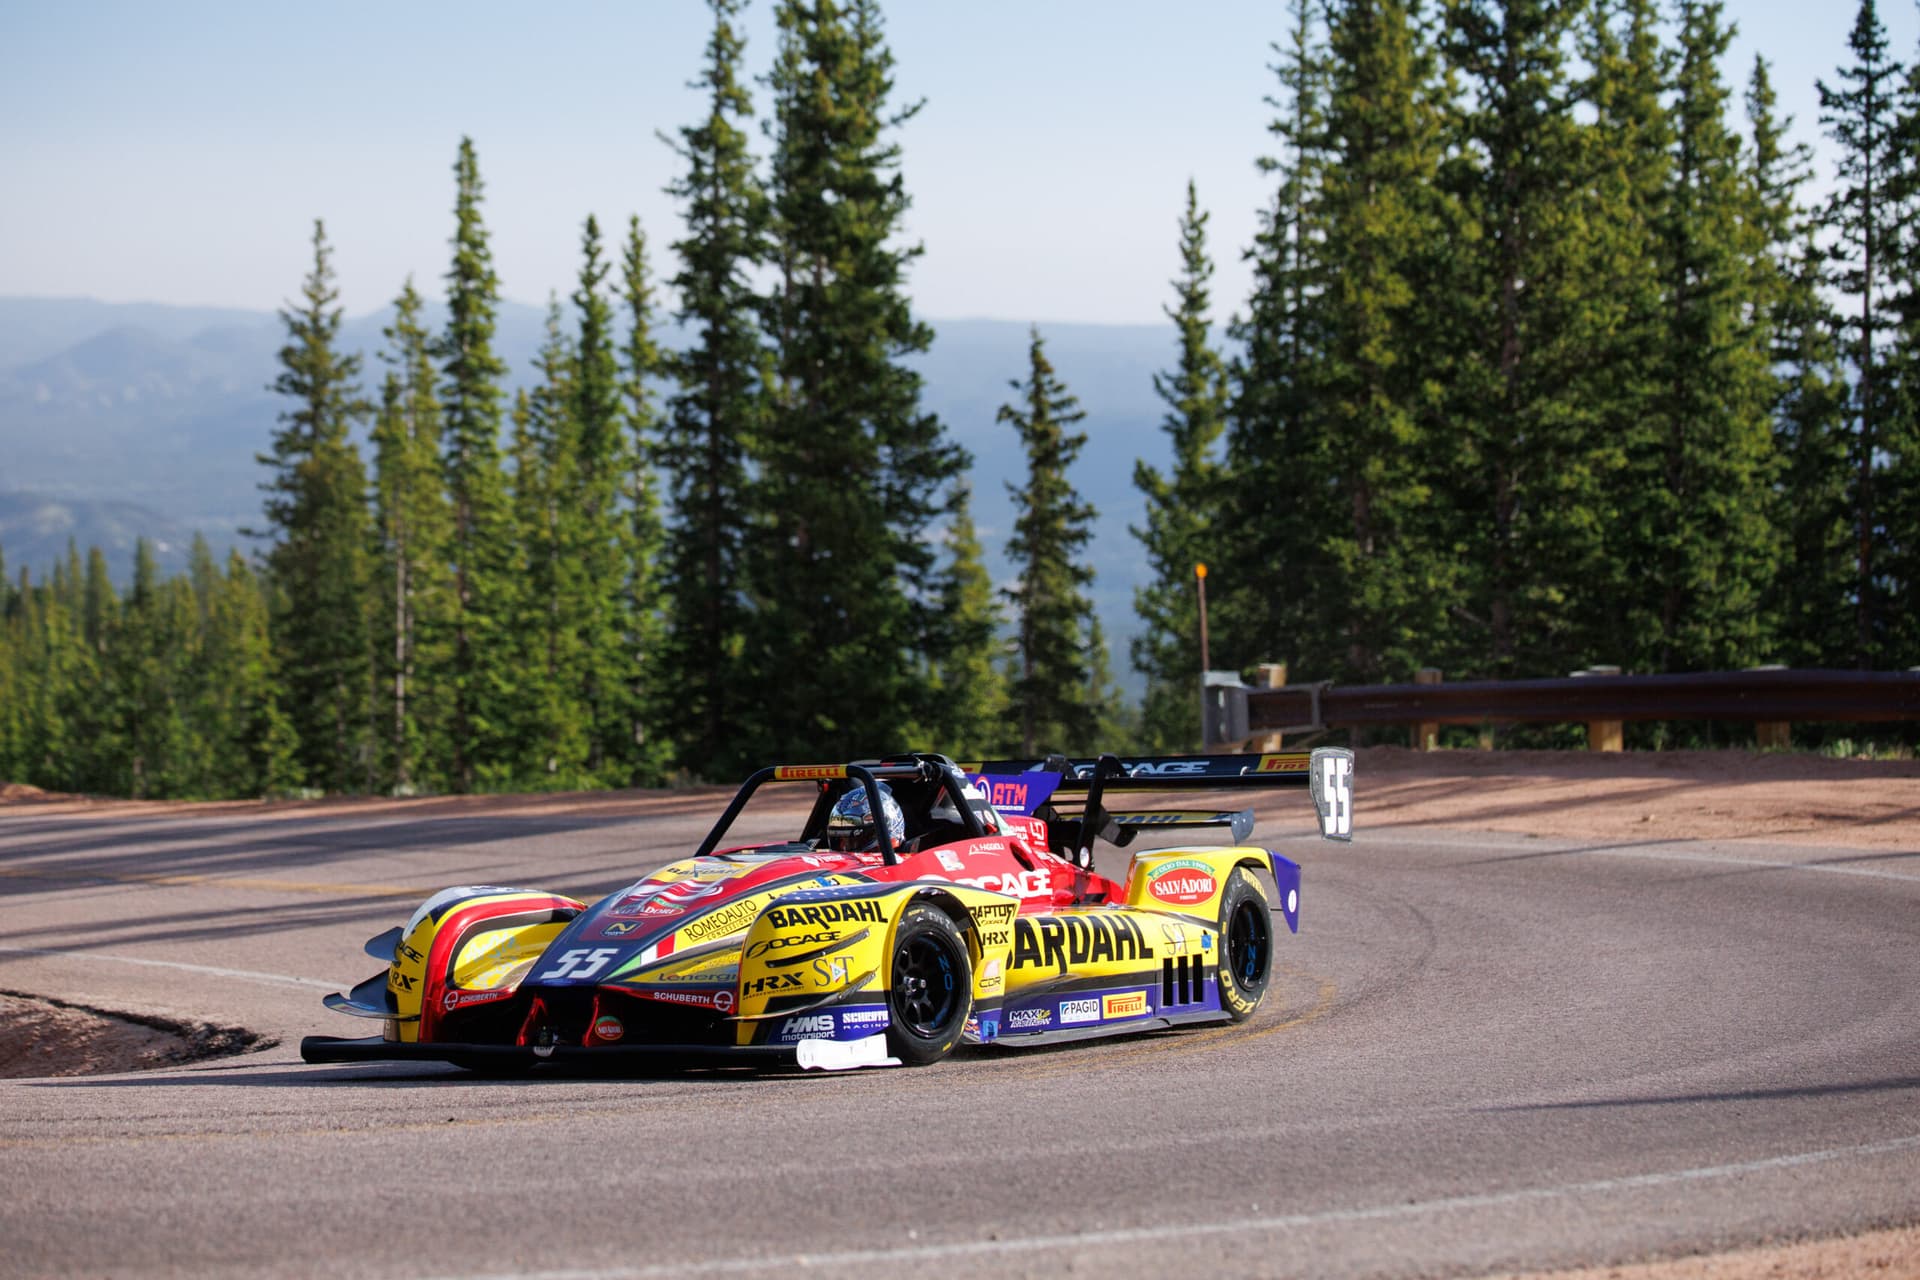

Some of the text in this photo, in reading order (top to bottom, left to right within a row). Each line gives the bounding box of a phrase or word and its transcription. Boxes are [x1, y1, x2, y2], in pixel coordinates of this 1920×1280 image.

[781, 766, 839, 778] PIRELLI
[992, 783, 1028, 805] ATM
[1323, 757, 1350, 835] 55
[1155, 877, 1213, 895] SALVADORI
[684, 900, 757, 940] ROMEOAUTO
[767, 900, 889, 930] BARDAHL
[982, 931, 1009, 946] HRX
[1006, 914, 1154, 976] ARDAHL
[539, 948, 619, 980] 55
[743, 971, 804, 997] HRX
[1219, 969, 1255, 1015] ZERO
[460, 991, 498, 1004] SCHUBERTH
[654, 991, 710, 1005] SCHUBERTH
[1070, 1000, 1099, 1014] PAGID
[1107, 996, 1143, 1014] PIRELLI
[781, 1014, 835, 1034] HMS
[843, 1022, 889, 1031] RACING
[781, 1031, 836, 1042] motorsport
